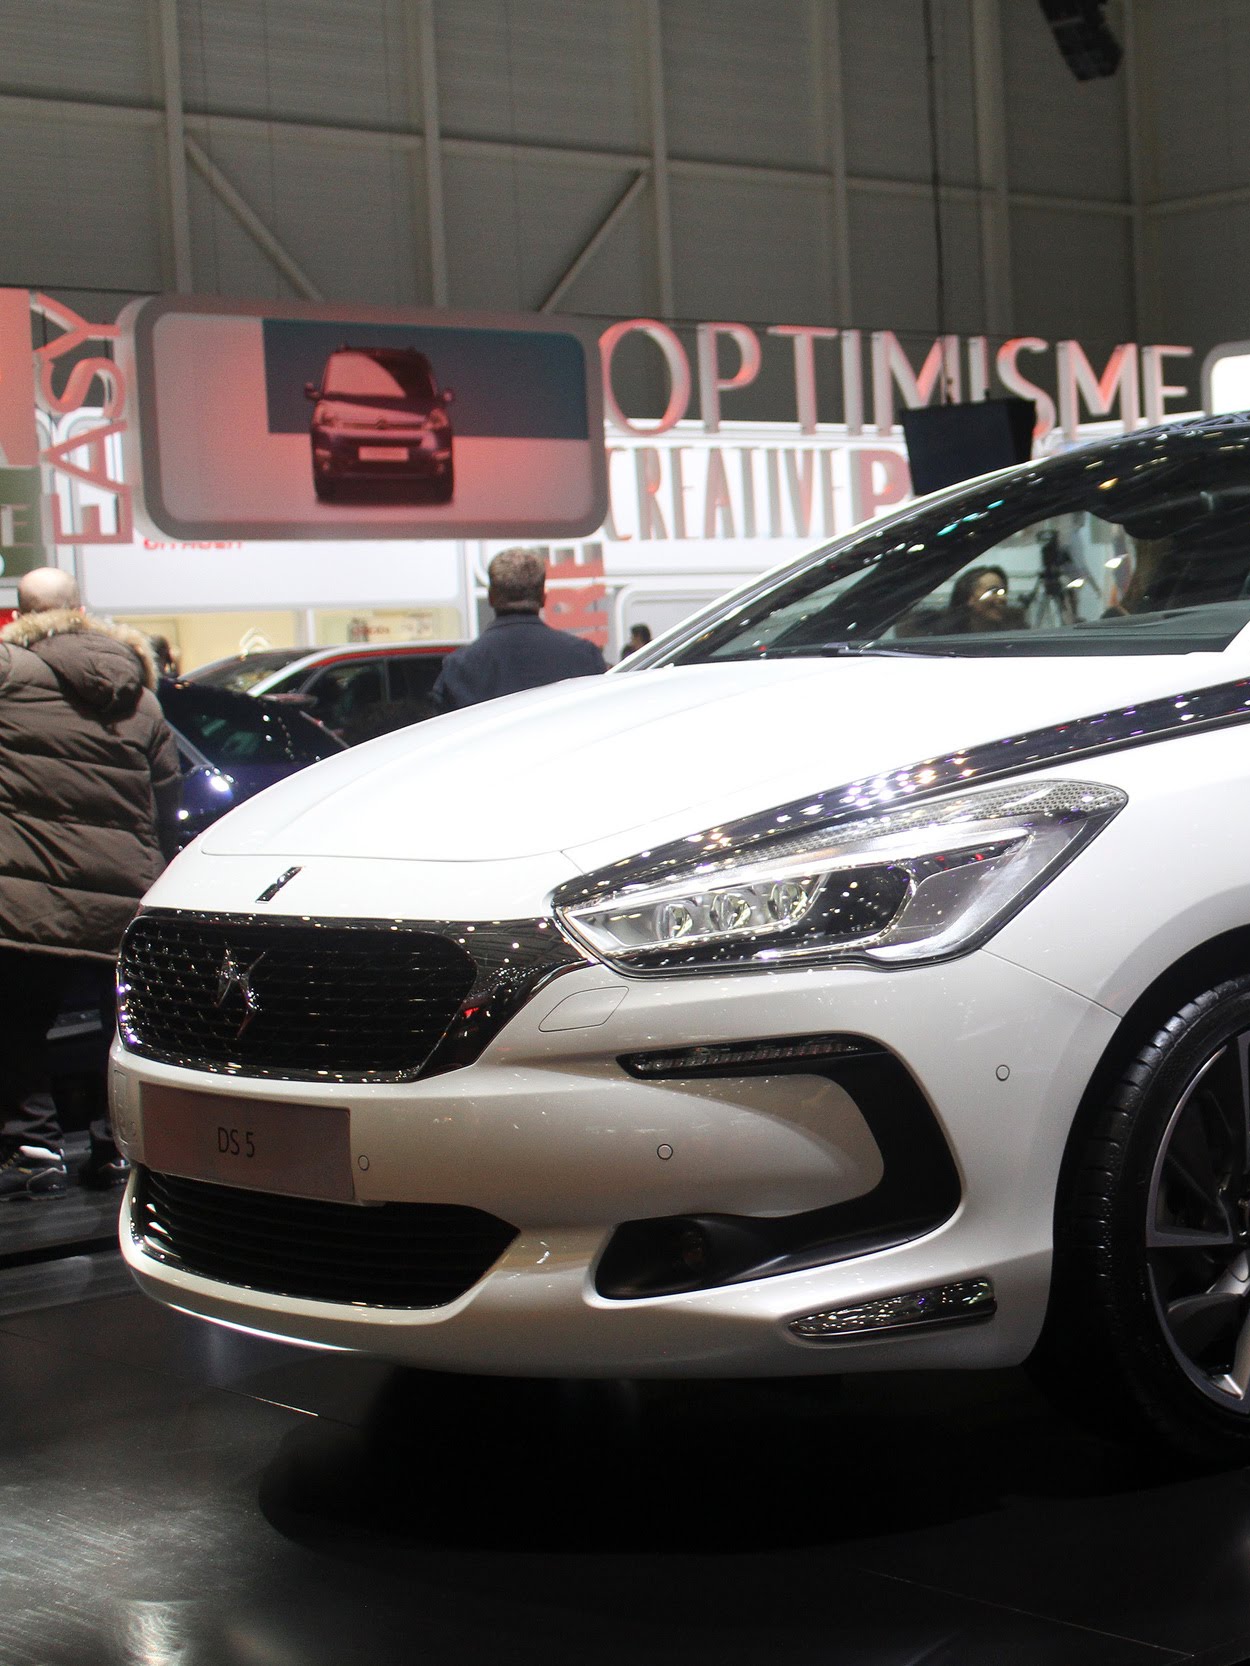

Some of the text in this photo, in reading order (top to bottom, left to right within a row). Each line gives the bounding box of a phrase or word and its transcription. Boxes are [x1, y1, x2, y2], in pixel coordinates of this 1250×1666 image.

[30, 291, 133, 544] EASY
[599, 318, 1194, 438] OPTIMISME
[217, 1126, 255, 1158] DS 5
